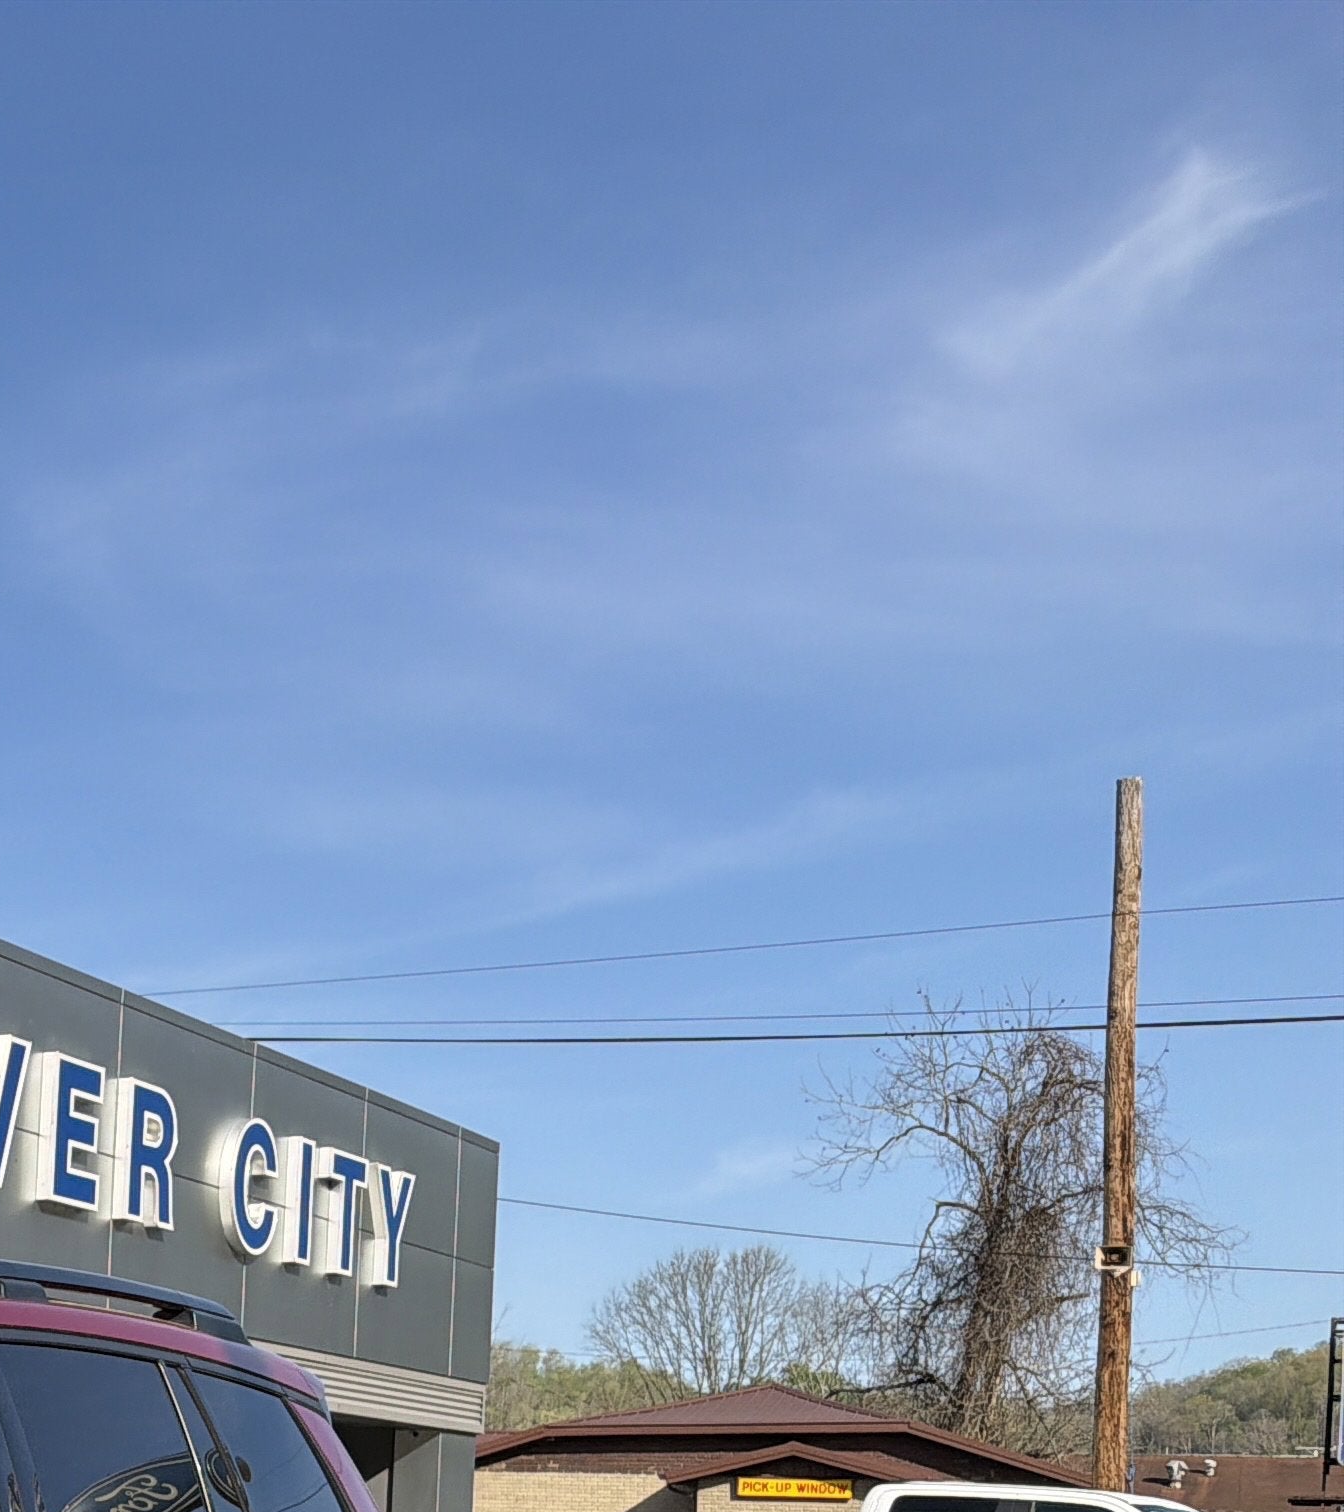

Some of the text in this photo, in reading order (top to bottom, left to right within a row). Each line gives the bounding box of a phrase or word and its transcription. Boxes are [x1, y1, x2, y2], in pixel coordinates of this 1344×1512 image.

[224, 1117, 416, 1289] CITY
[742, 1481, 849, 1495] PICK-UP WINDOW
